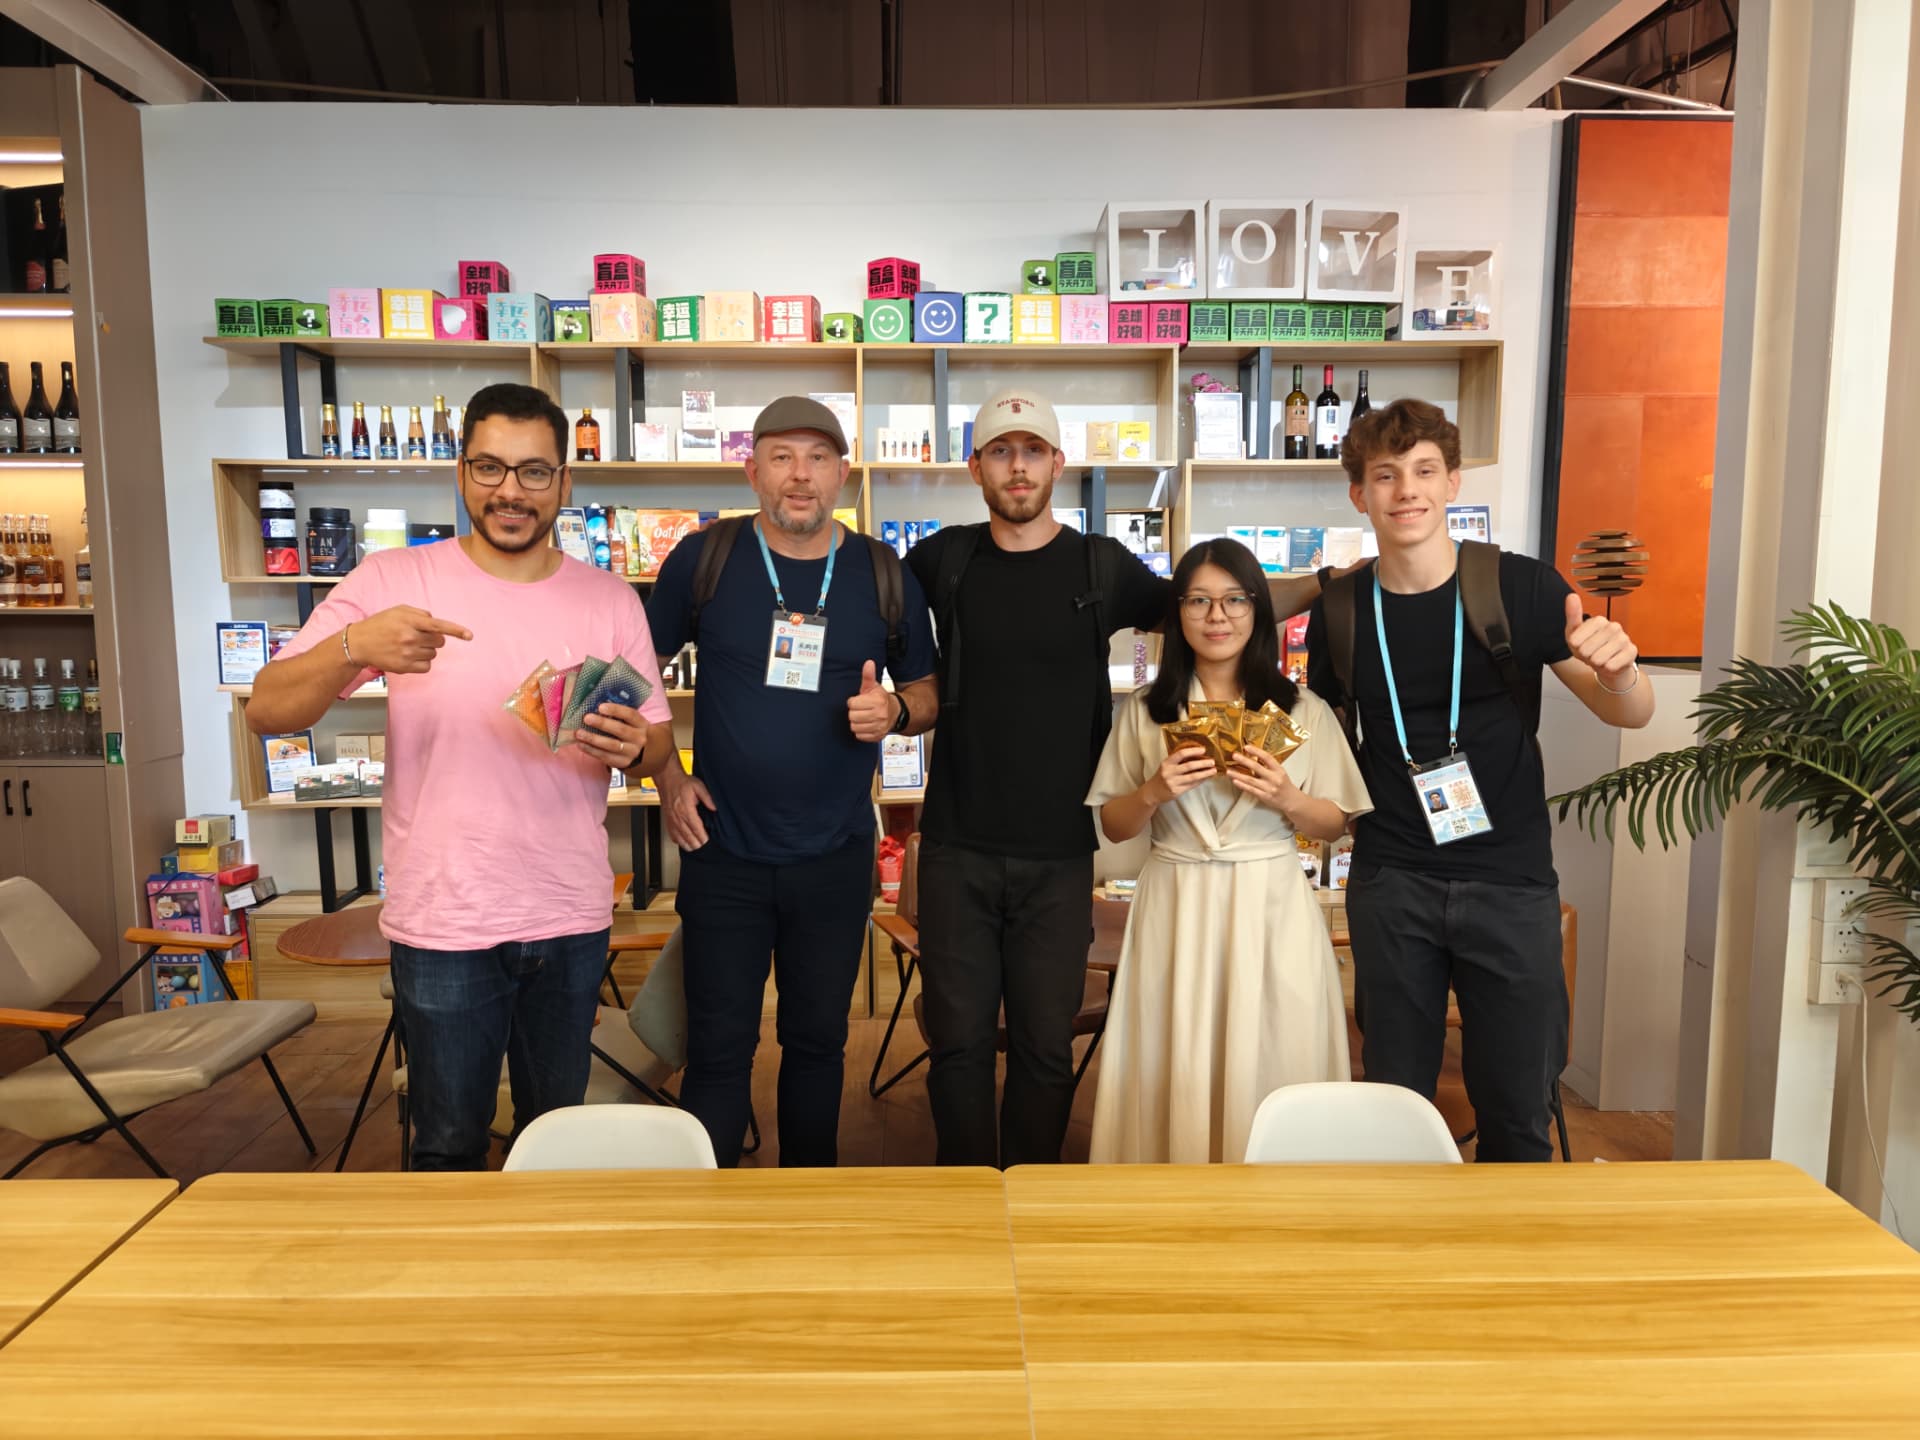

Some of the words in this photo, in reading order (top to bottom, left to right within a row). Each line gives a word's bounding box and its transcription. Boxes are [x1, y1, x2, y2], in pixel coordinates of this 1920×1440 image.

[1142, 228, 1181, 273] L
[1231, 219, 1277, 265] O
[1338, 231, 1381, 276] V
[465, 265, 491, 280] 全球
[597, 261, 629, 281] 盲盒
[1059, 260, 1094, 279] 盲盒
[465, 281, 492, 296] 好物
[219, 305, 255, 324] 盲盒
[1117, 308, 1143, 323] 全球
[1156, 308, 1182, 323] 全球
[1194, 307, 1226, 326] 盲盒
[1233, 309, 1267, 327] 盲盒
[1273, 308, 1307, 327] 盲盒
[1311, 309, 1345, 328] 盲盒
[1350, 309, 1384, 328] 盲盒
[1117, 324, 1143, 339] 好物
[1156, 324, 1182, 338] 好物
[653, 524, 674, 539] Oat
